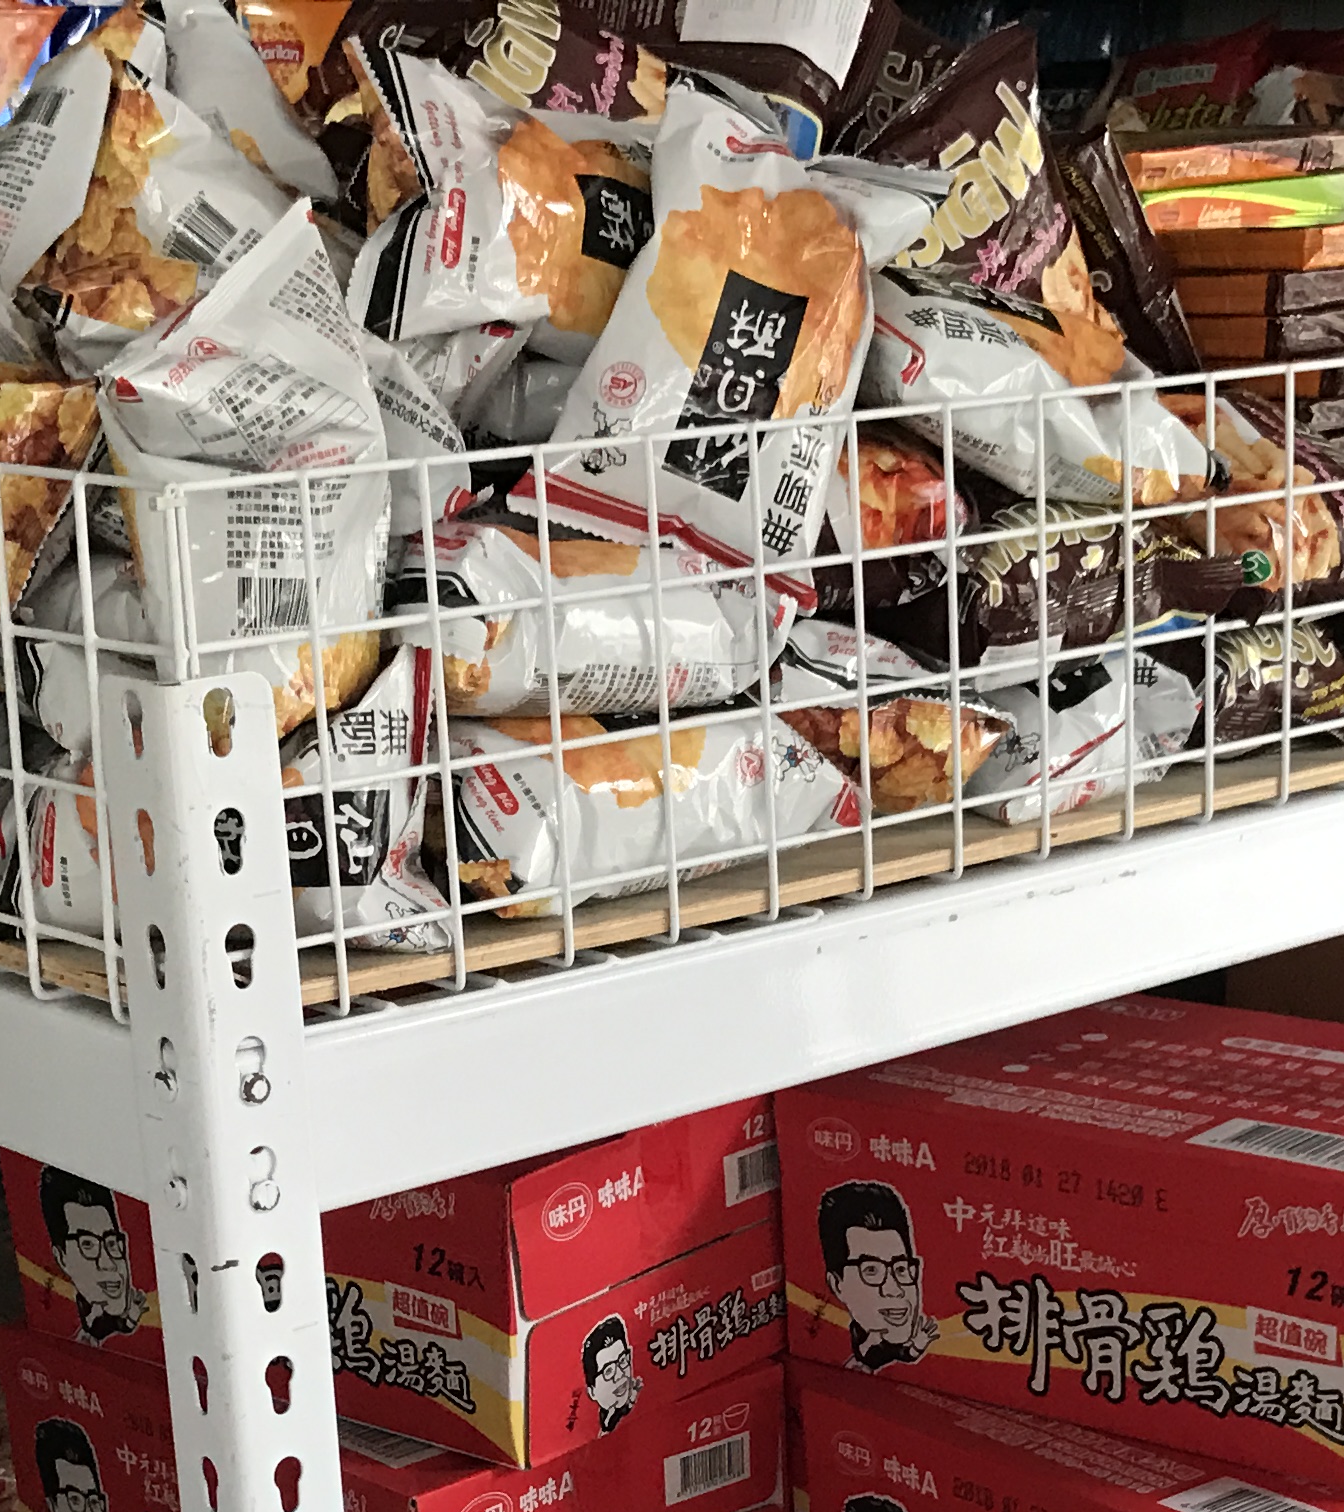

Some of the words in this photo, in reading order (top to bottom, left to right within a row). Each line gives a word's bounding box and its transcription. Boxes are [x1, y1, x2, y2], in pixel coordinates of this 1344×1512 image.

[742, 1115, 765, 1141] 12
[868, 1133, 937, 1173] 味味A
[1057, 1169, 1082, 1195] 27
[547, 1195, 588, 1229] 味丹
[392, 1287, 451, 1331] 超值碗
[1255, 1313, 1328, 1357] 超值碗
[882, 1454, 939, 1500] 味味A
